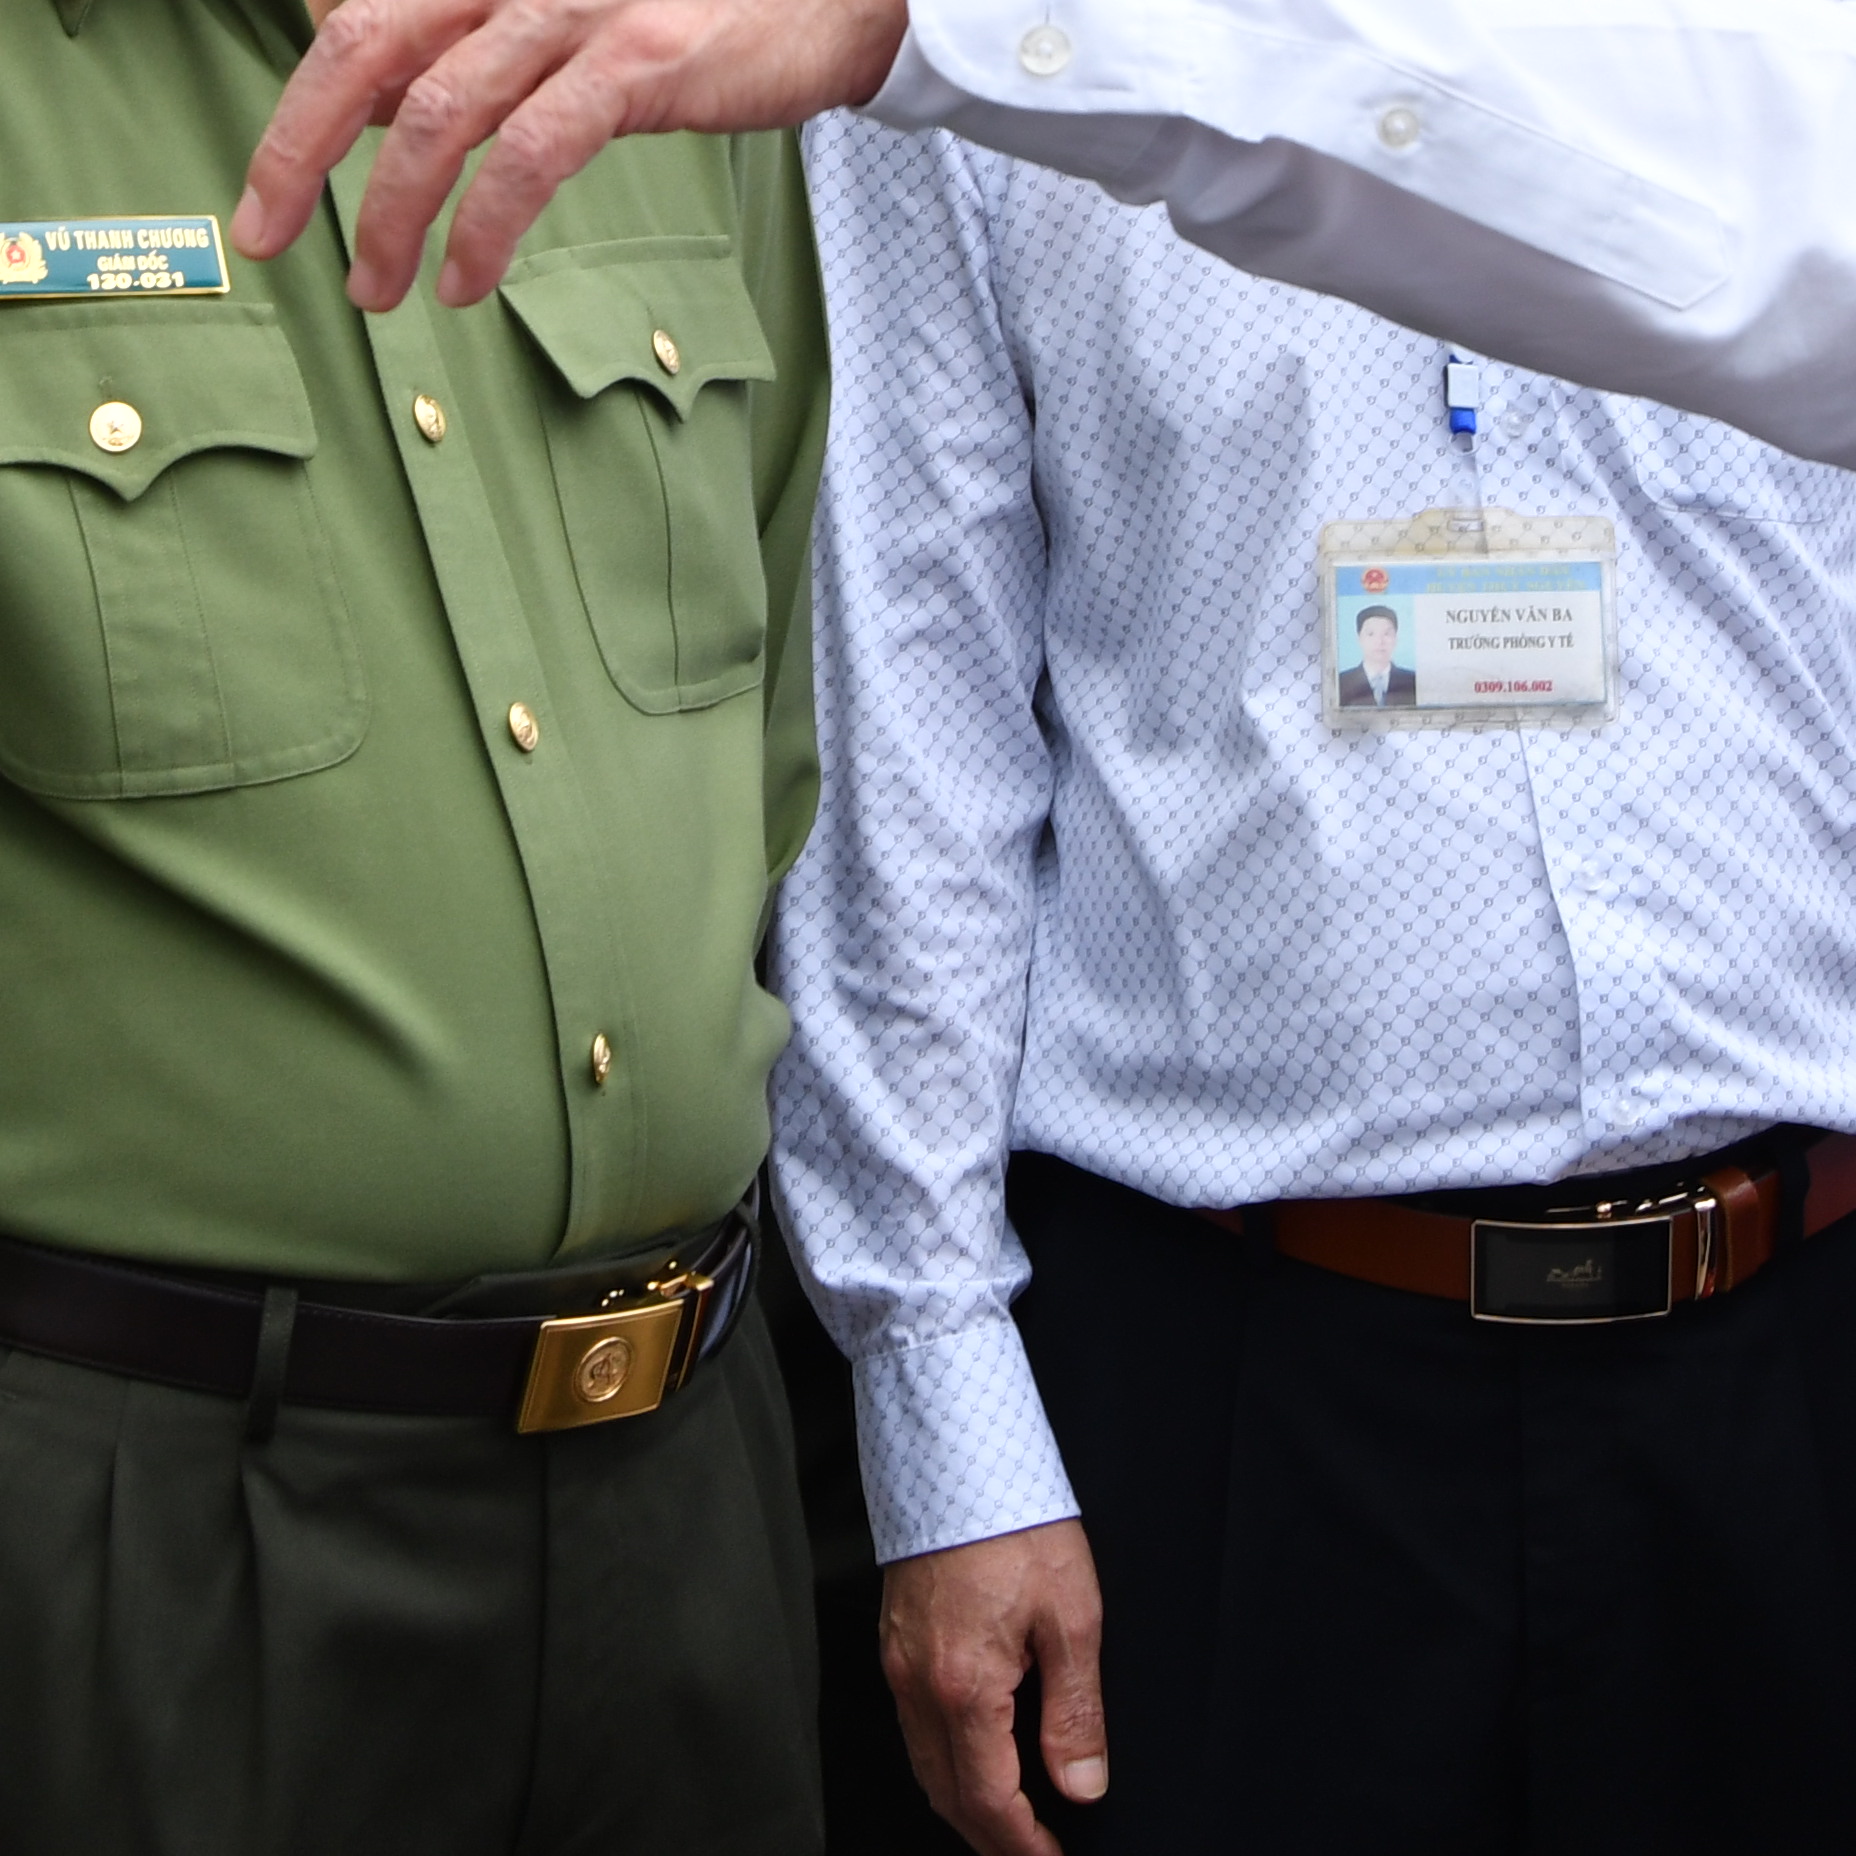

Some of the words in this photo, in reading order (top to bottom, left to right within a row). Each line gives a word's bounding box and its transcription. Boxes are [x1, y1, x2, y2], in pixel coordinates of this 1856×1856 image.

[74, 229, 134, 251] THANH
[1515, 605, 1549, 622] VĂN
[1552, 607, 1573, 622] BA
